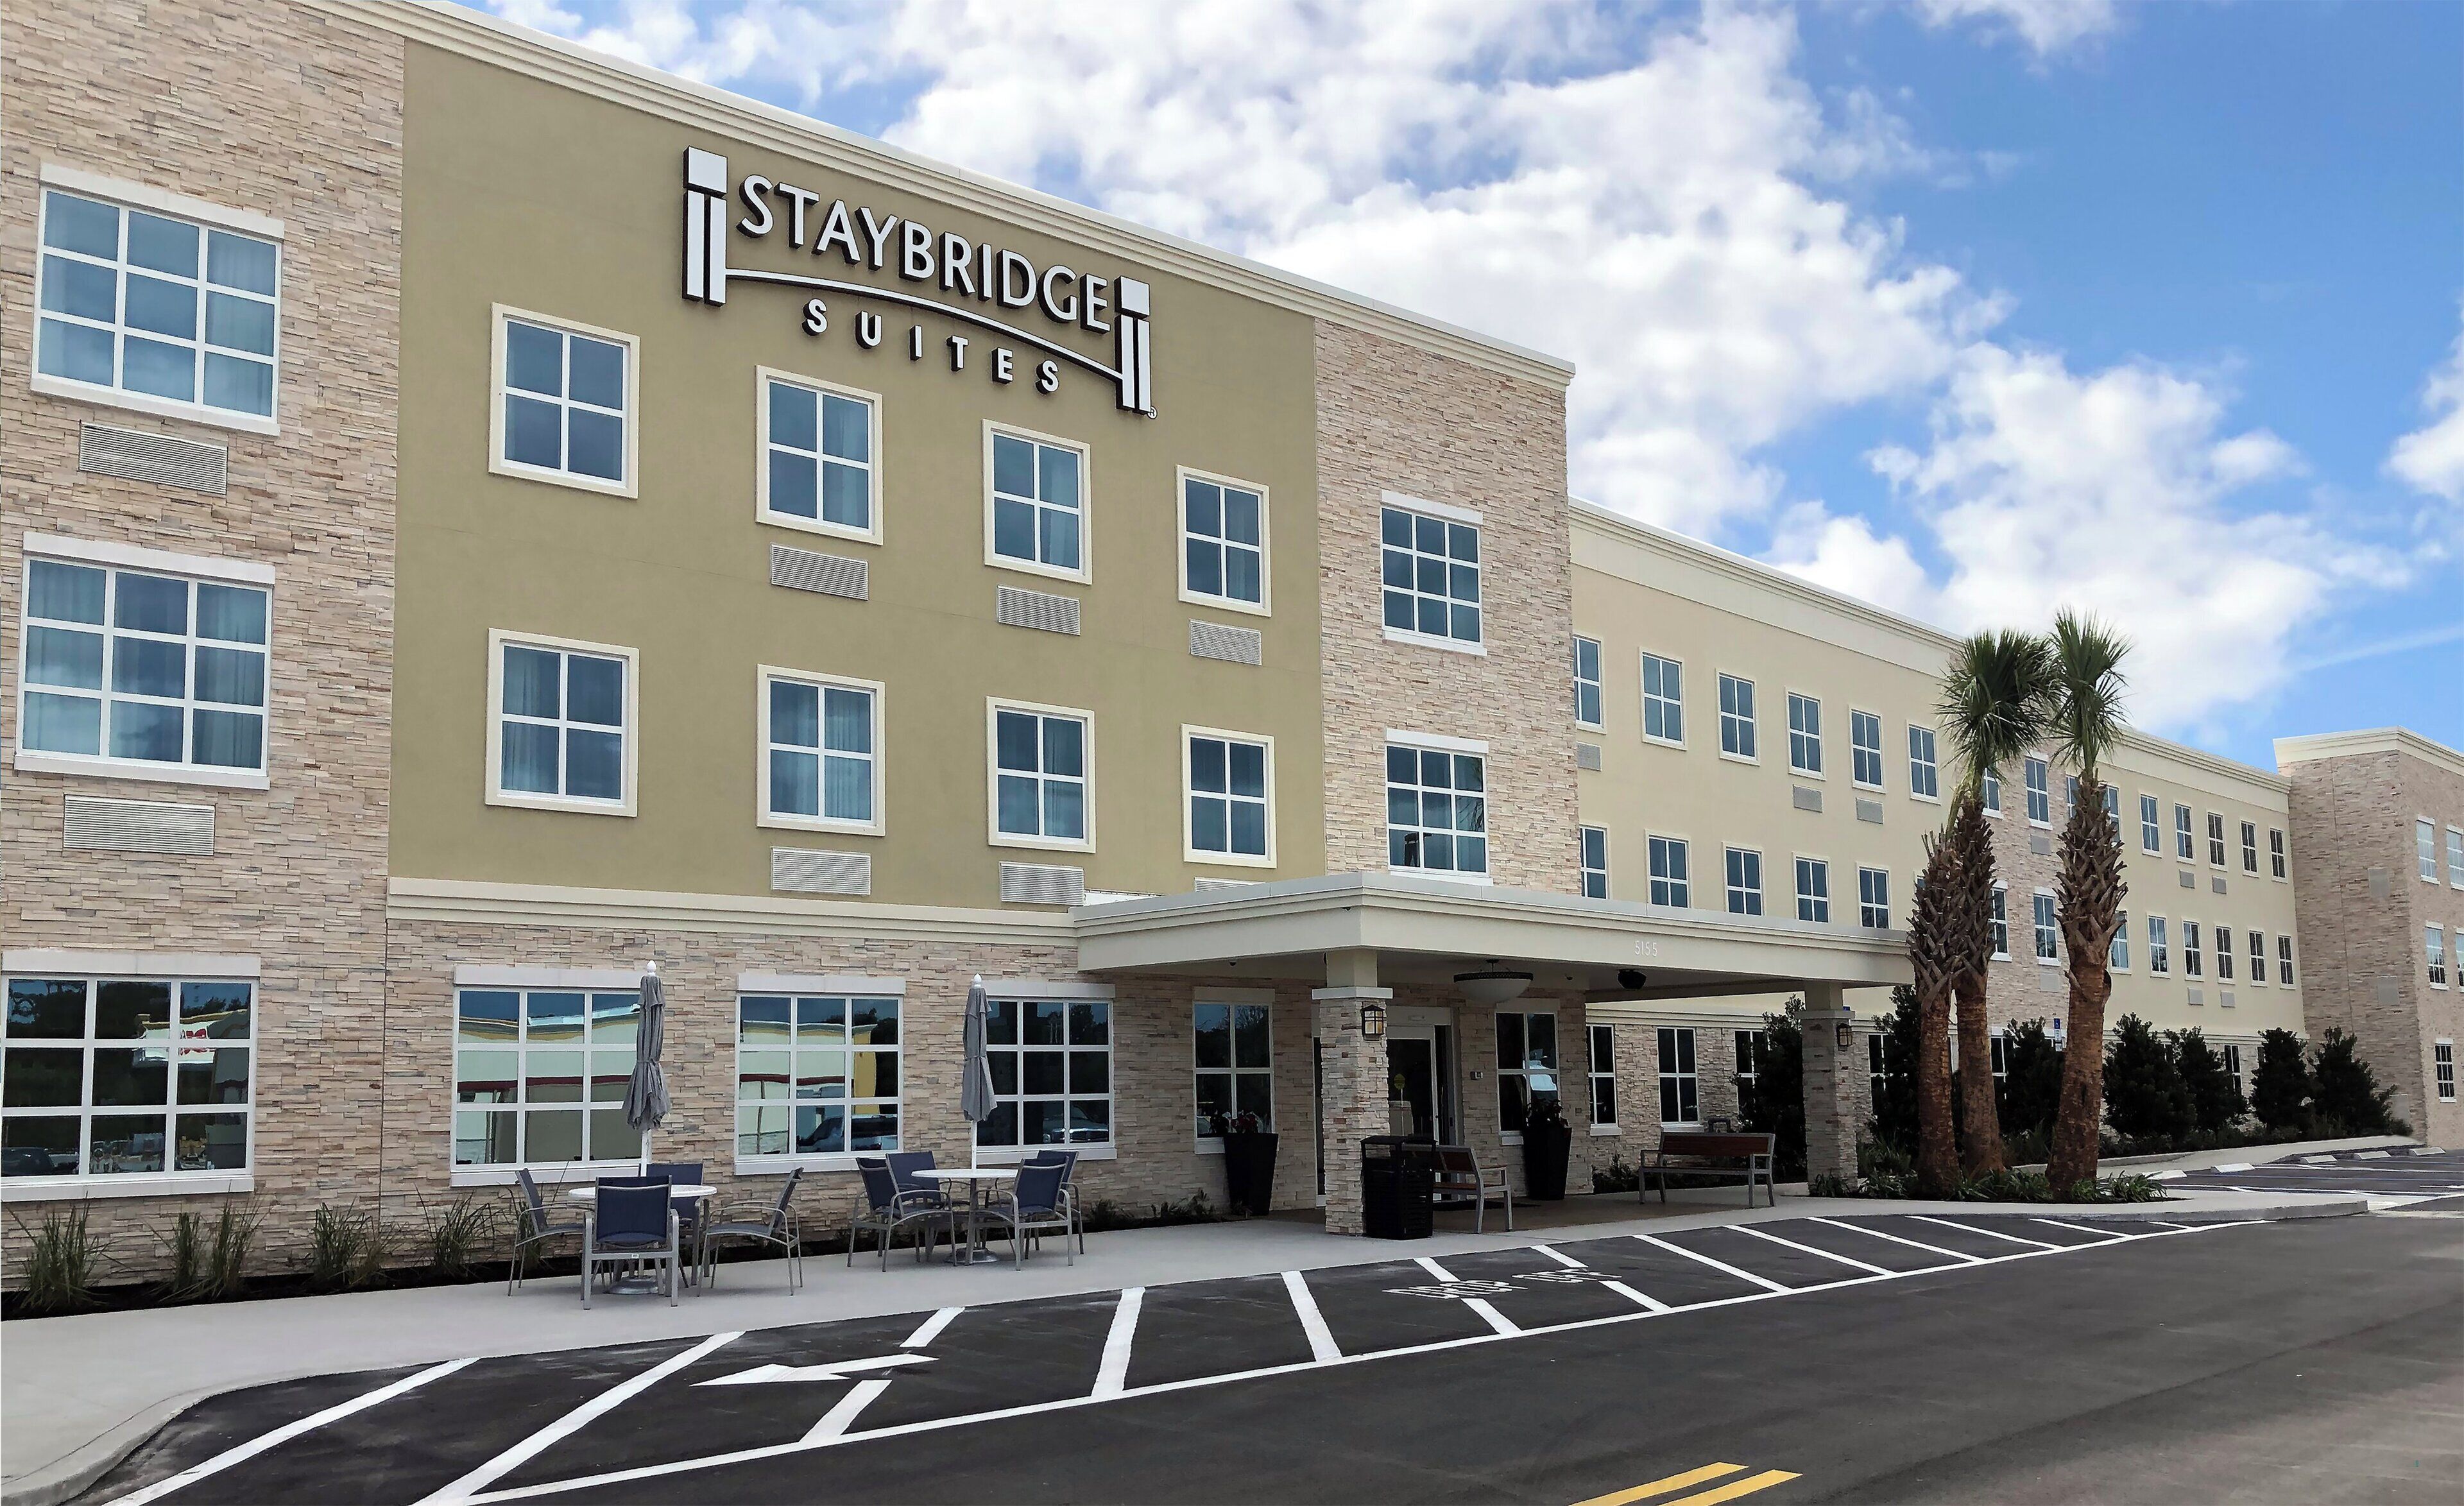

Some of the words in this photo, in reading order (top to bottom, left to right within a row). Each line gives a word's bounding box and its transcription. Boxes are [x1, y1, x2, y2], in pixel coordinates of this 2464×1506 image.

[737, 175, 1111, 334] STAYBRIDGE
[802, 298, 1059, 395] SUITES
[1634, 941, 1657, 957] 5155
[1382, 1279, 1528, 1299] DROP
[1512, 1269, 1622, 1283] OFF
